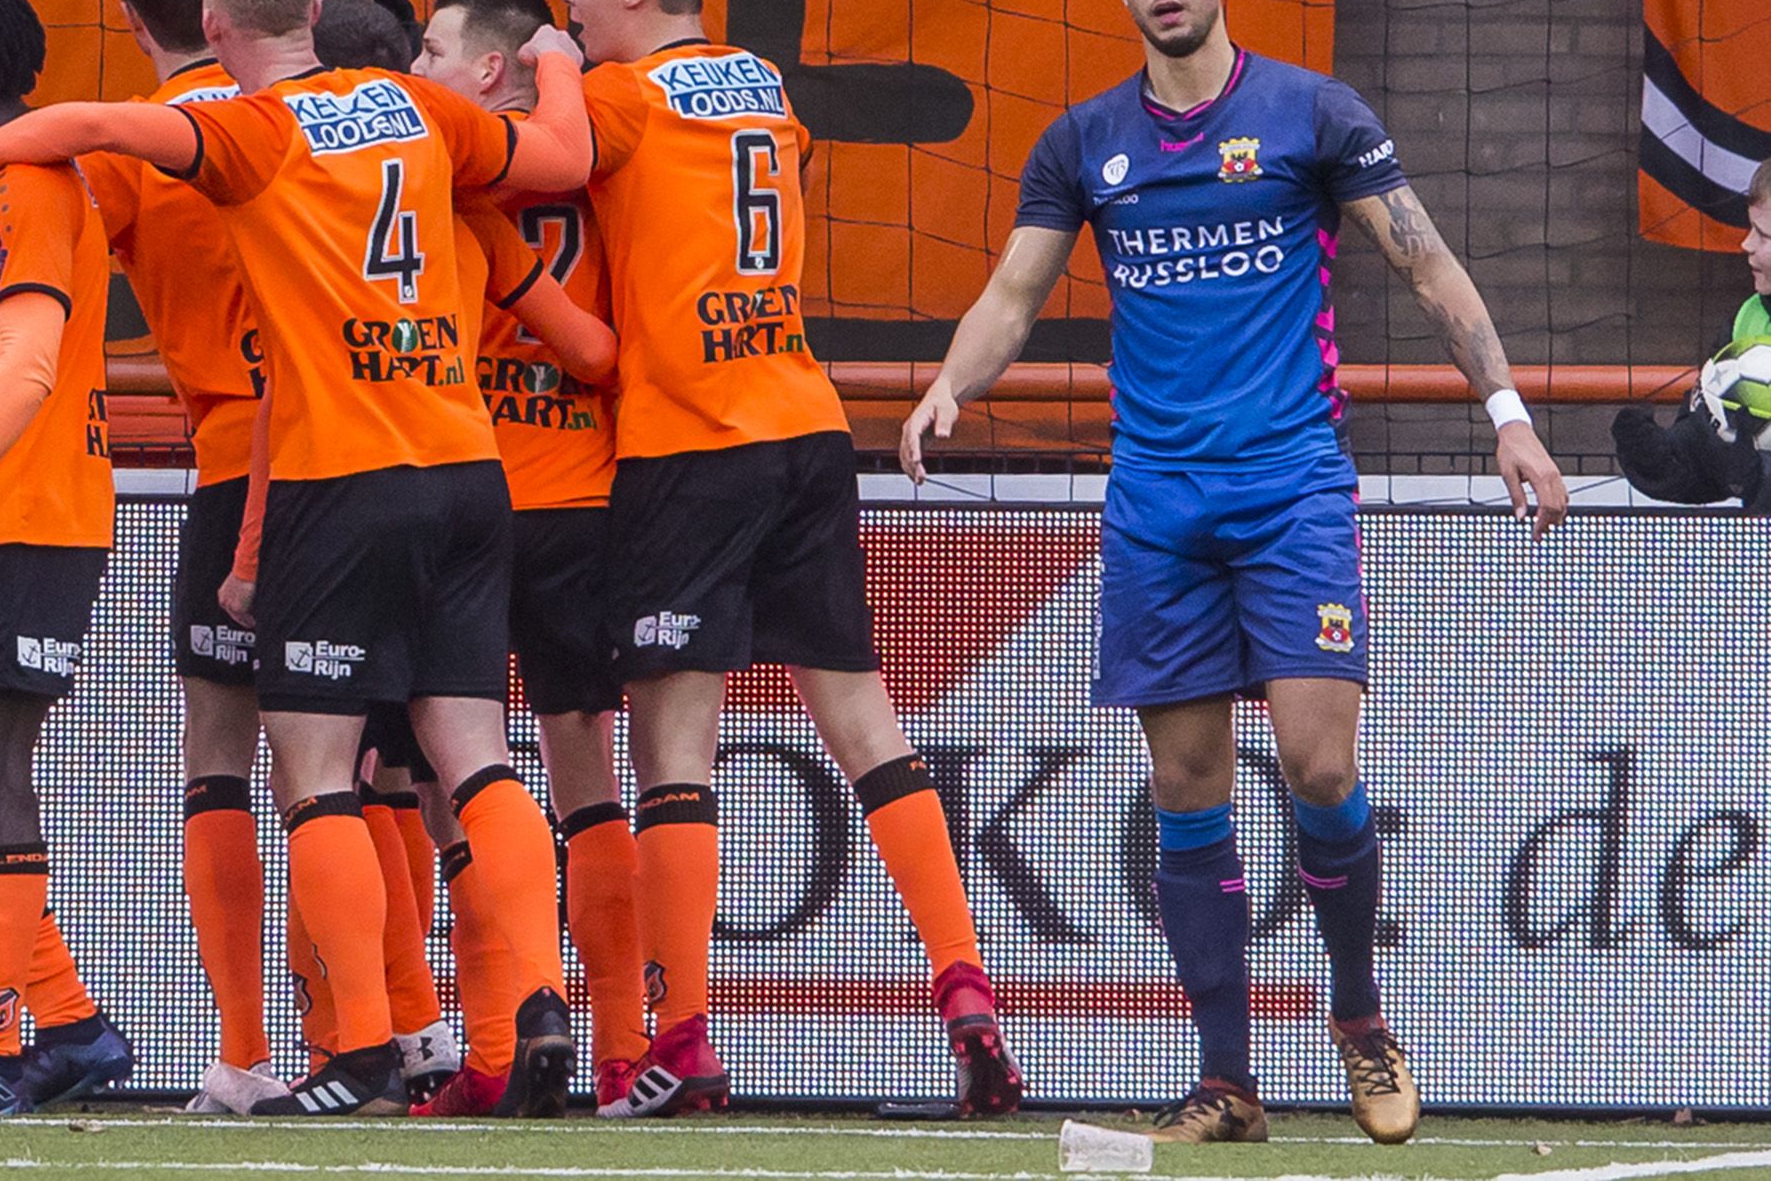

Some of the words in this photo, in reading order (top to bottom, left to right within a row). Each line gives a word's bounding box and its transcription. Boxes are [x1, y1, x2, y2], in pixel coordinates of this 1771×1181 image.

[658, 57, 777, 92] KEUKEN
[730, 128, 782, 276] 6
[363, 158, 426, 304] 4
[1108, 216, 1284, 256] THERMEN
[215, 644, 248, 665] Rijn
[315, 640, 366, 658] Euro-
[658, 630, 690, 650] Rijn
[314, 660, 351, 680] Rijn
[1505, 744, 1759, 951] de
